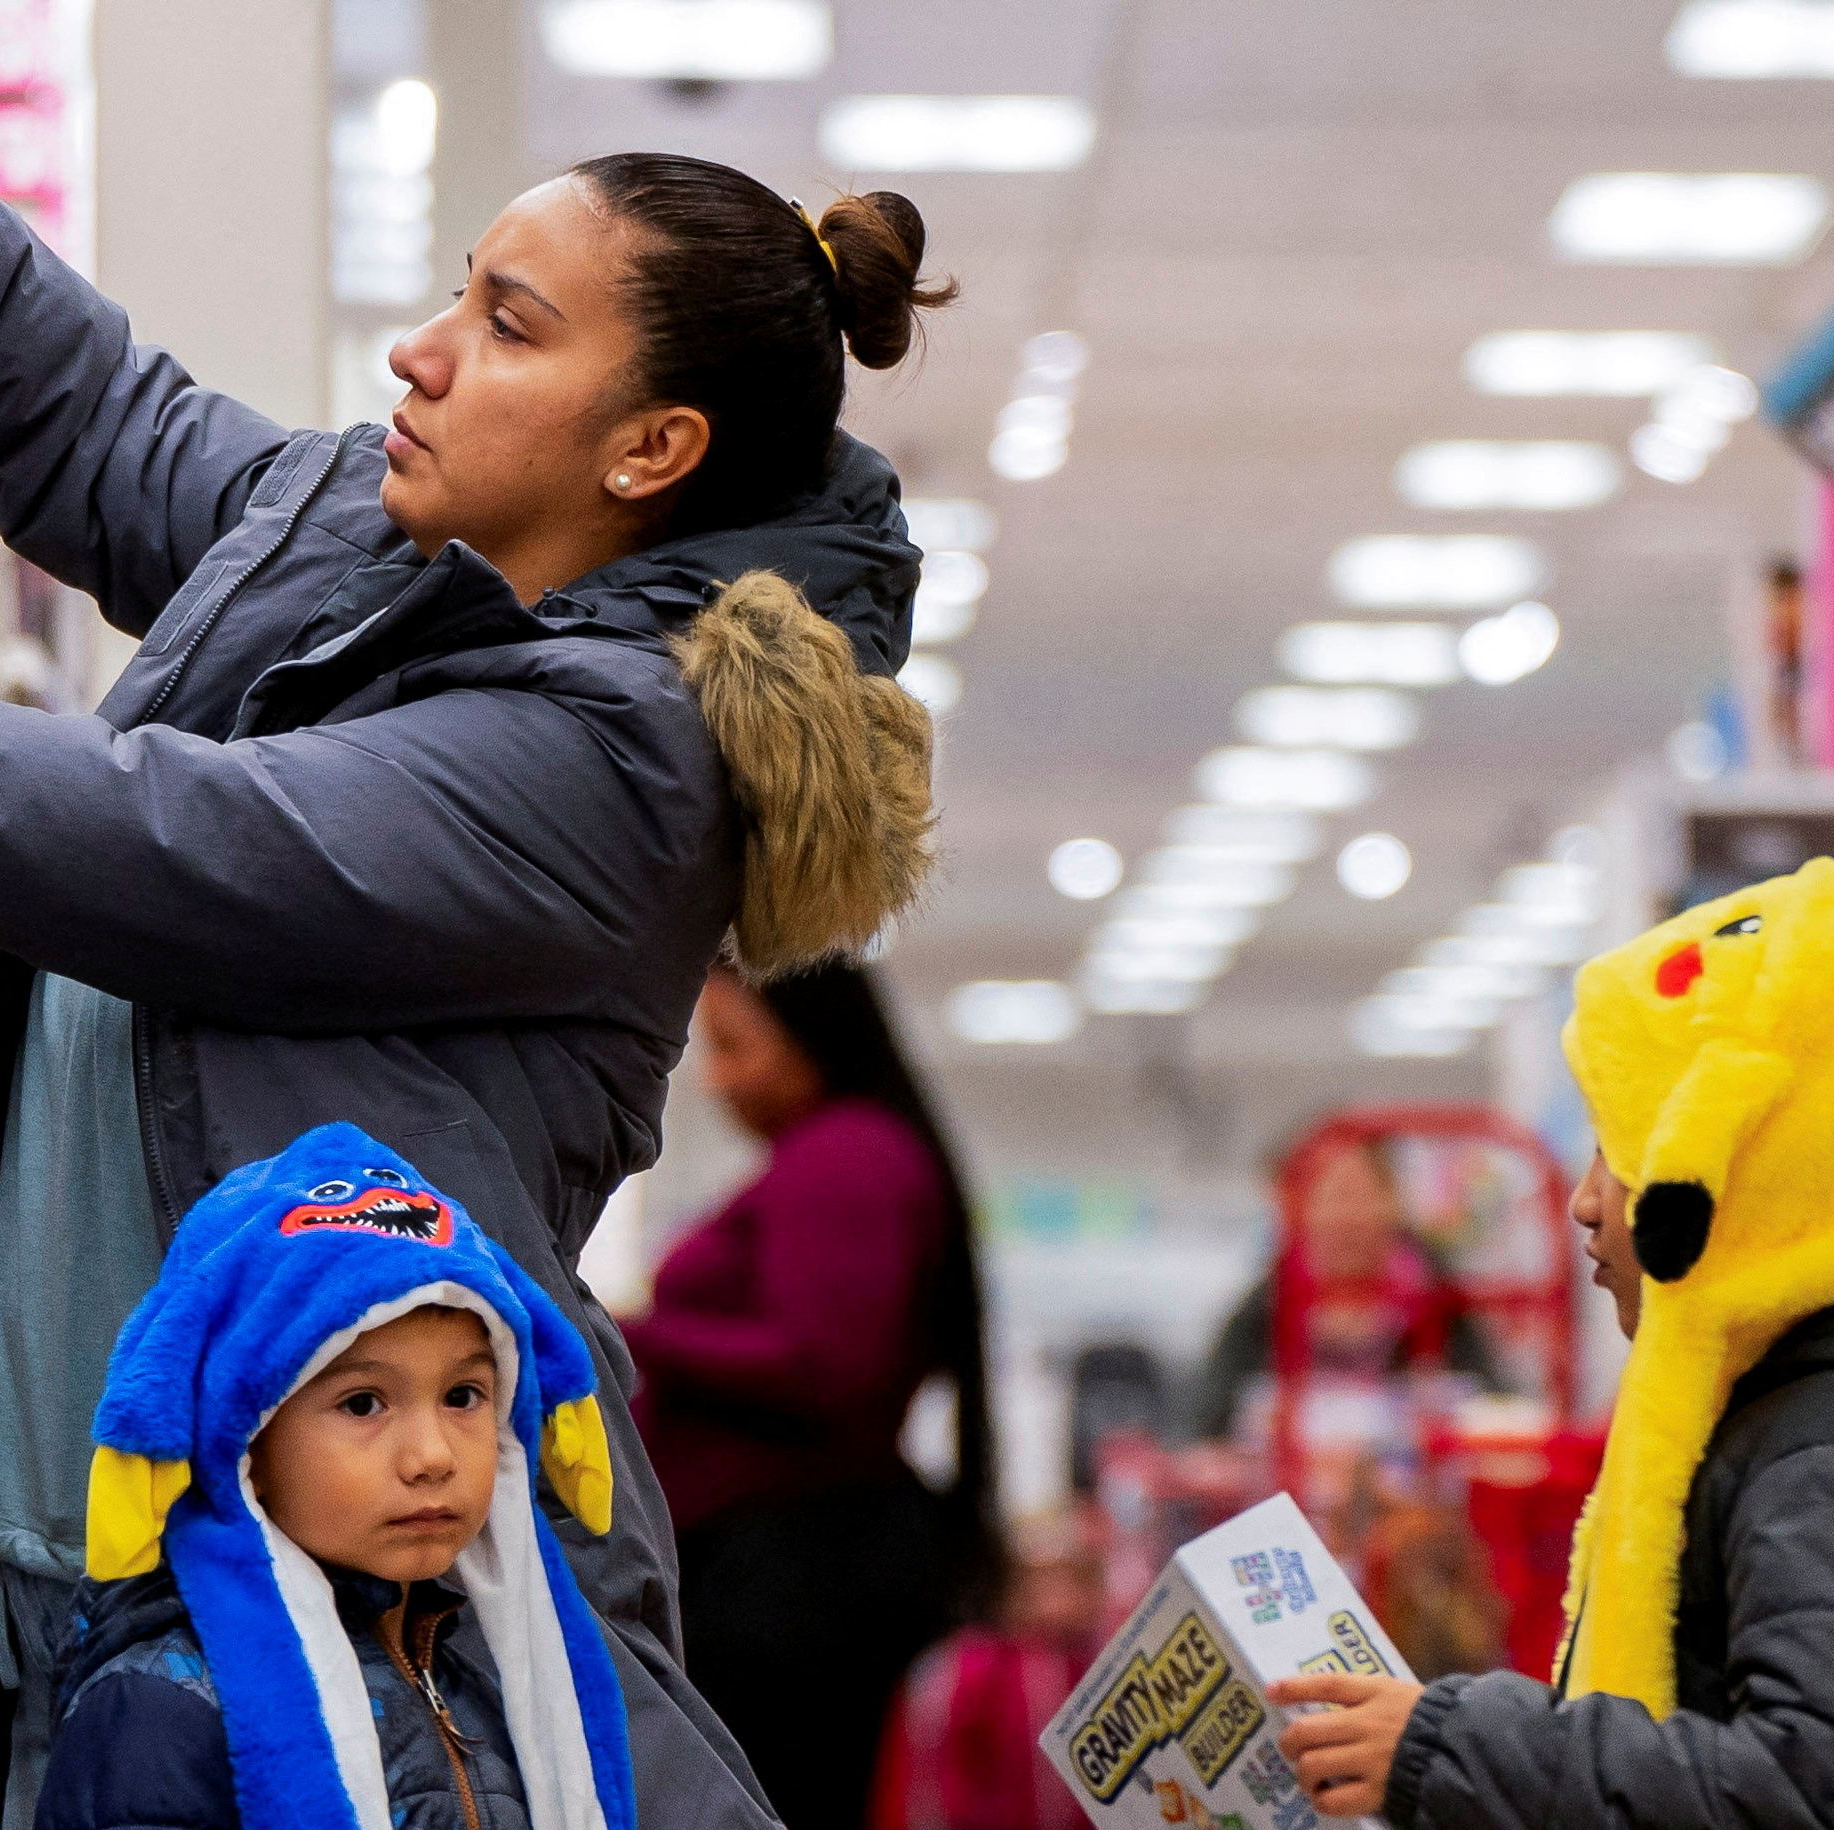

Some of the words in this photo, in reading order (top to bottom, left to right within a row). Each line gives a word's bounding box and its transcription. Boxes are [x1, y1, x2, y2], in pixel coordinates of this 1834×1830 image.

[1075, 1668, 1161, 1788] GRAVITY
[1159, 1624, 1217, 1720] MAZE
[1190, 1688, 1258, 1773] BUILDER
